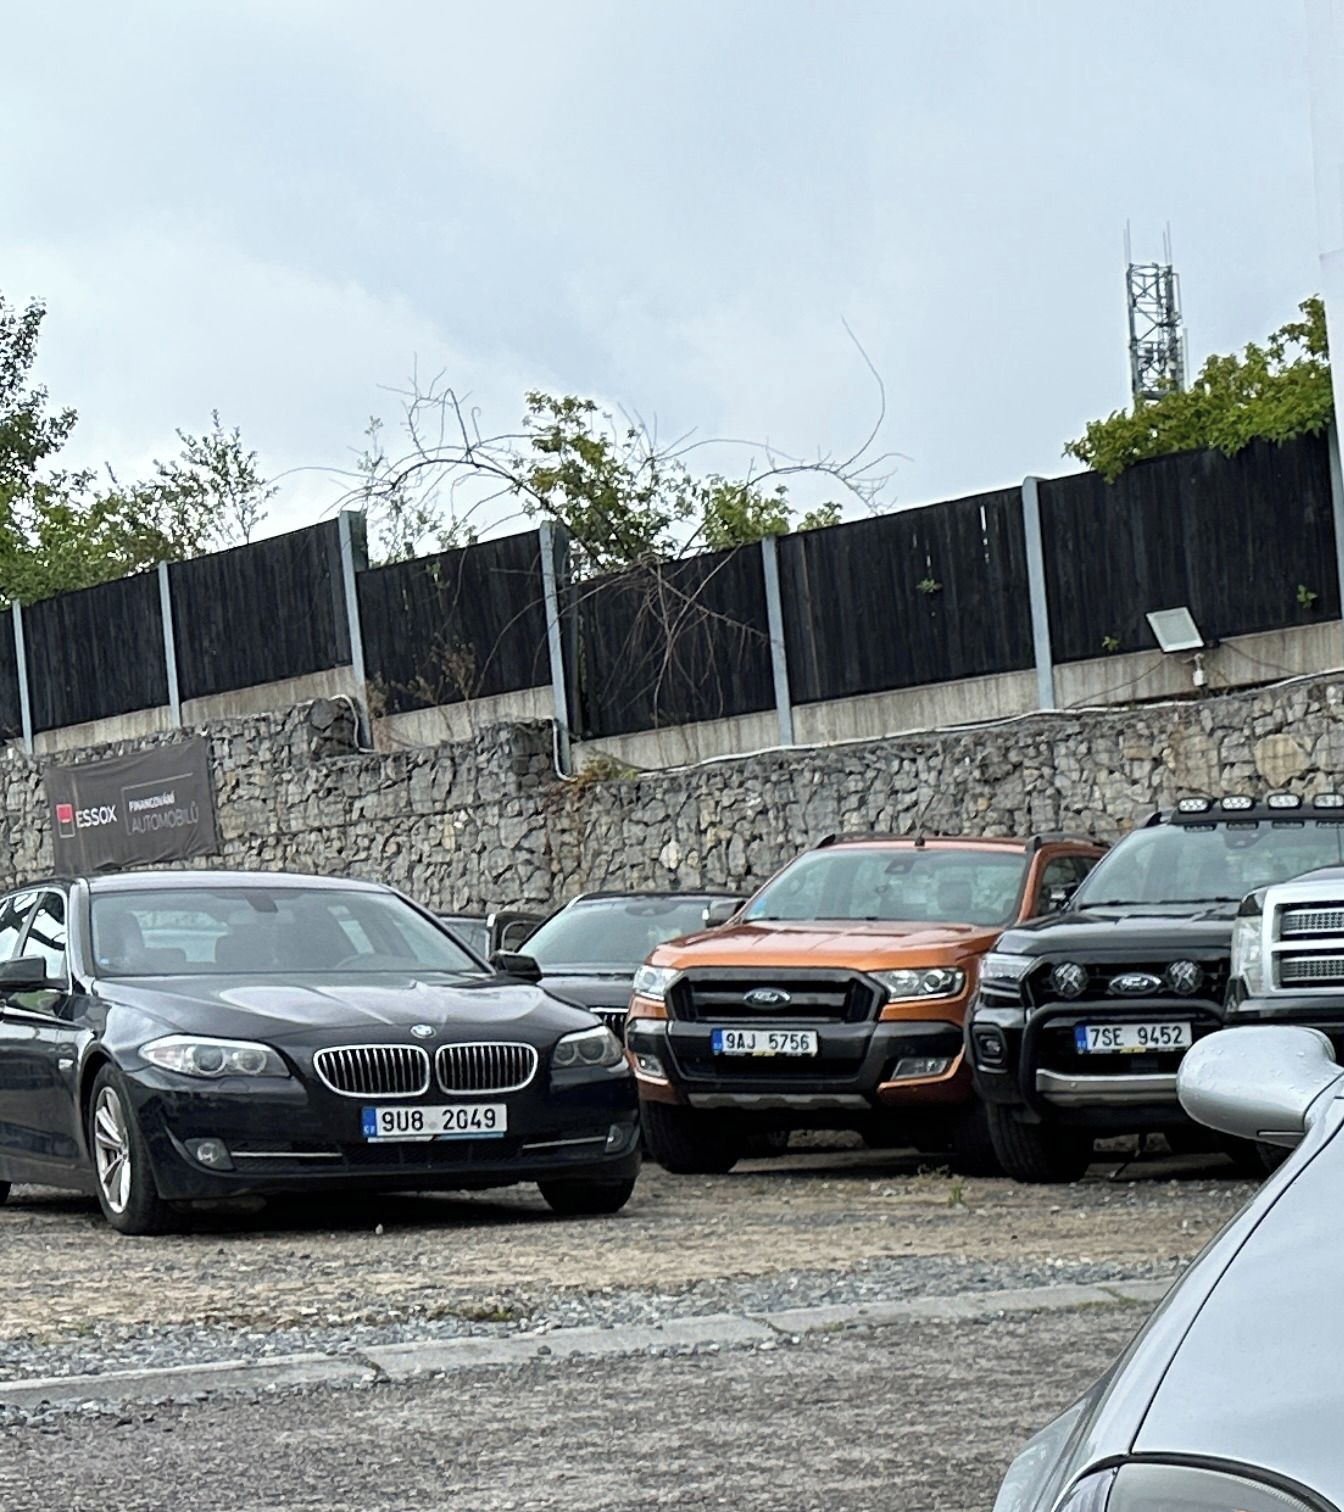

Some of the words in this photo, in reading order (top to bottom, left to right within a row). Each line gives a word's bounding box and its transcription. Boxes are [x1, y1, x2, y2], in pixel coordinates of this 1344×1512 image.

[75, 805, 118, 829] ESSOX
[726, 1032, 756, 1050] 9AJ
[768, 1033, 810, 1051] 5756
[1090, 1027, 1124, 1047] 7SE
[1137, 1026, 1183, 1045] 9452
[382, 1110, 424, 1132] 9U8
[442, 1108, 496, 1131] 2049
